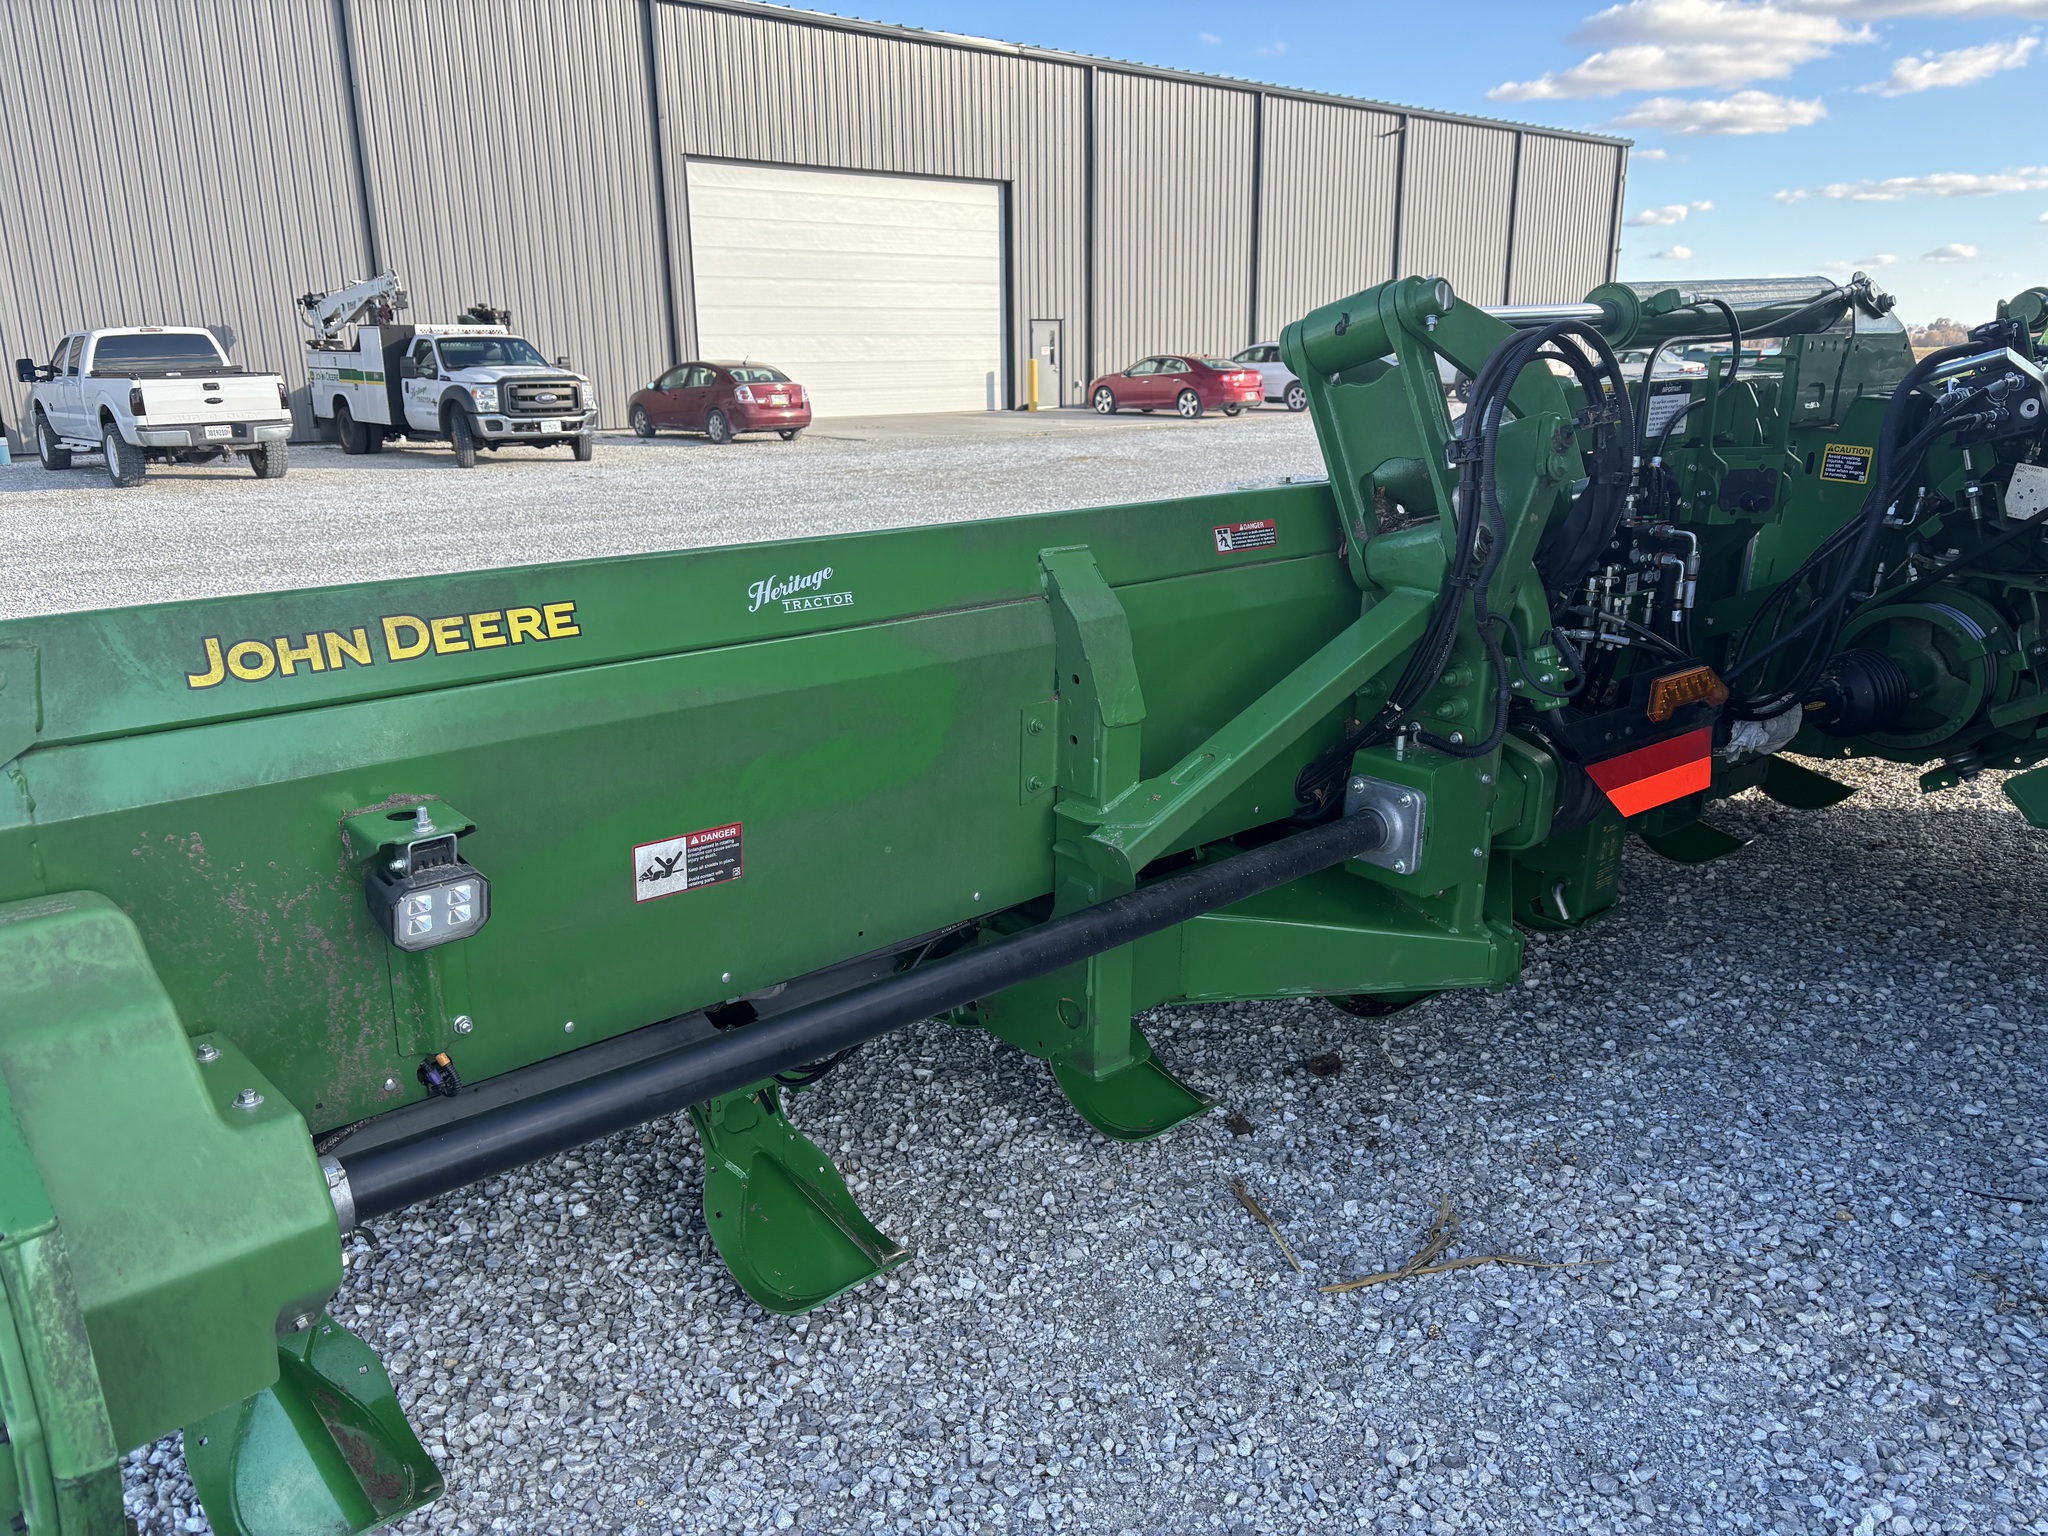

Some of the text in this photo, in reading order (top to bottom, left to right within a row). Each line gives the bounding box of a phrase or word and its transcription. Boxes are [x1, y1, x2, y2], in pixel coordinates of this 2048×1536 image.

[1834, 446, 1870, 455] CAUTION
[748, 566, 834, 612] Heritage
[782, 594, 854, 611] TRACTOR
[185, 600, 582, 690] JOHN DEERE
[701, 828, 736, 842] DANGER
